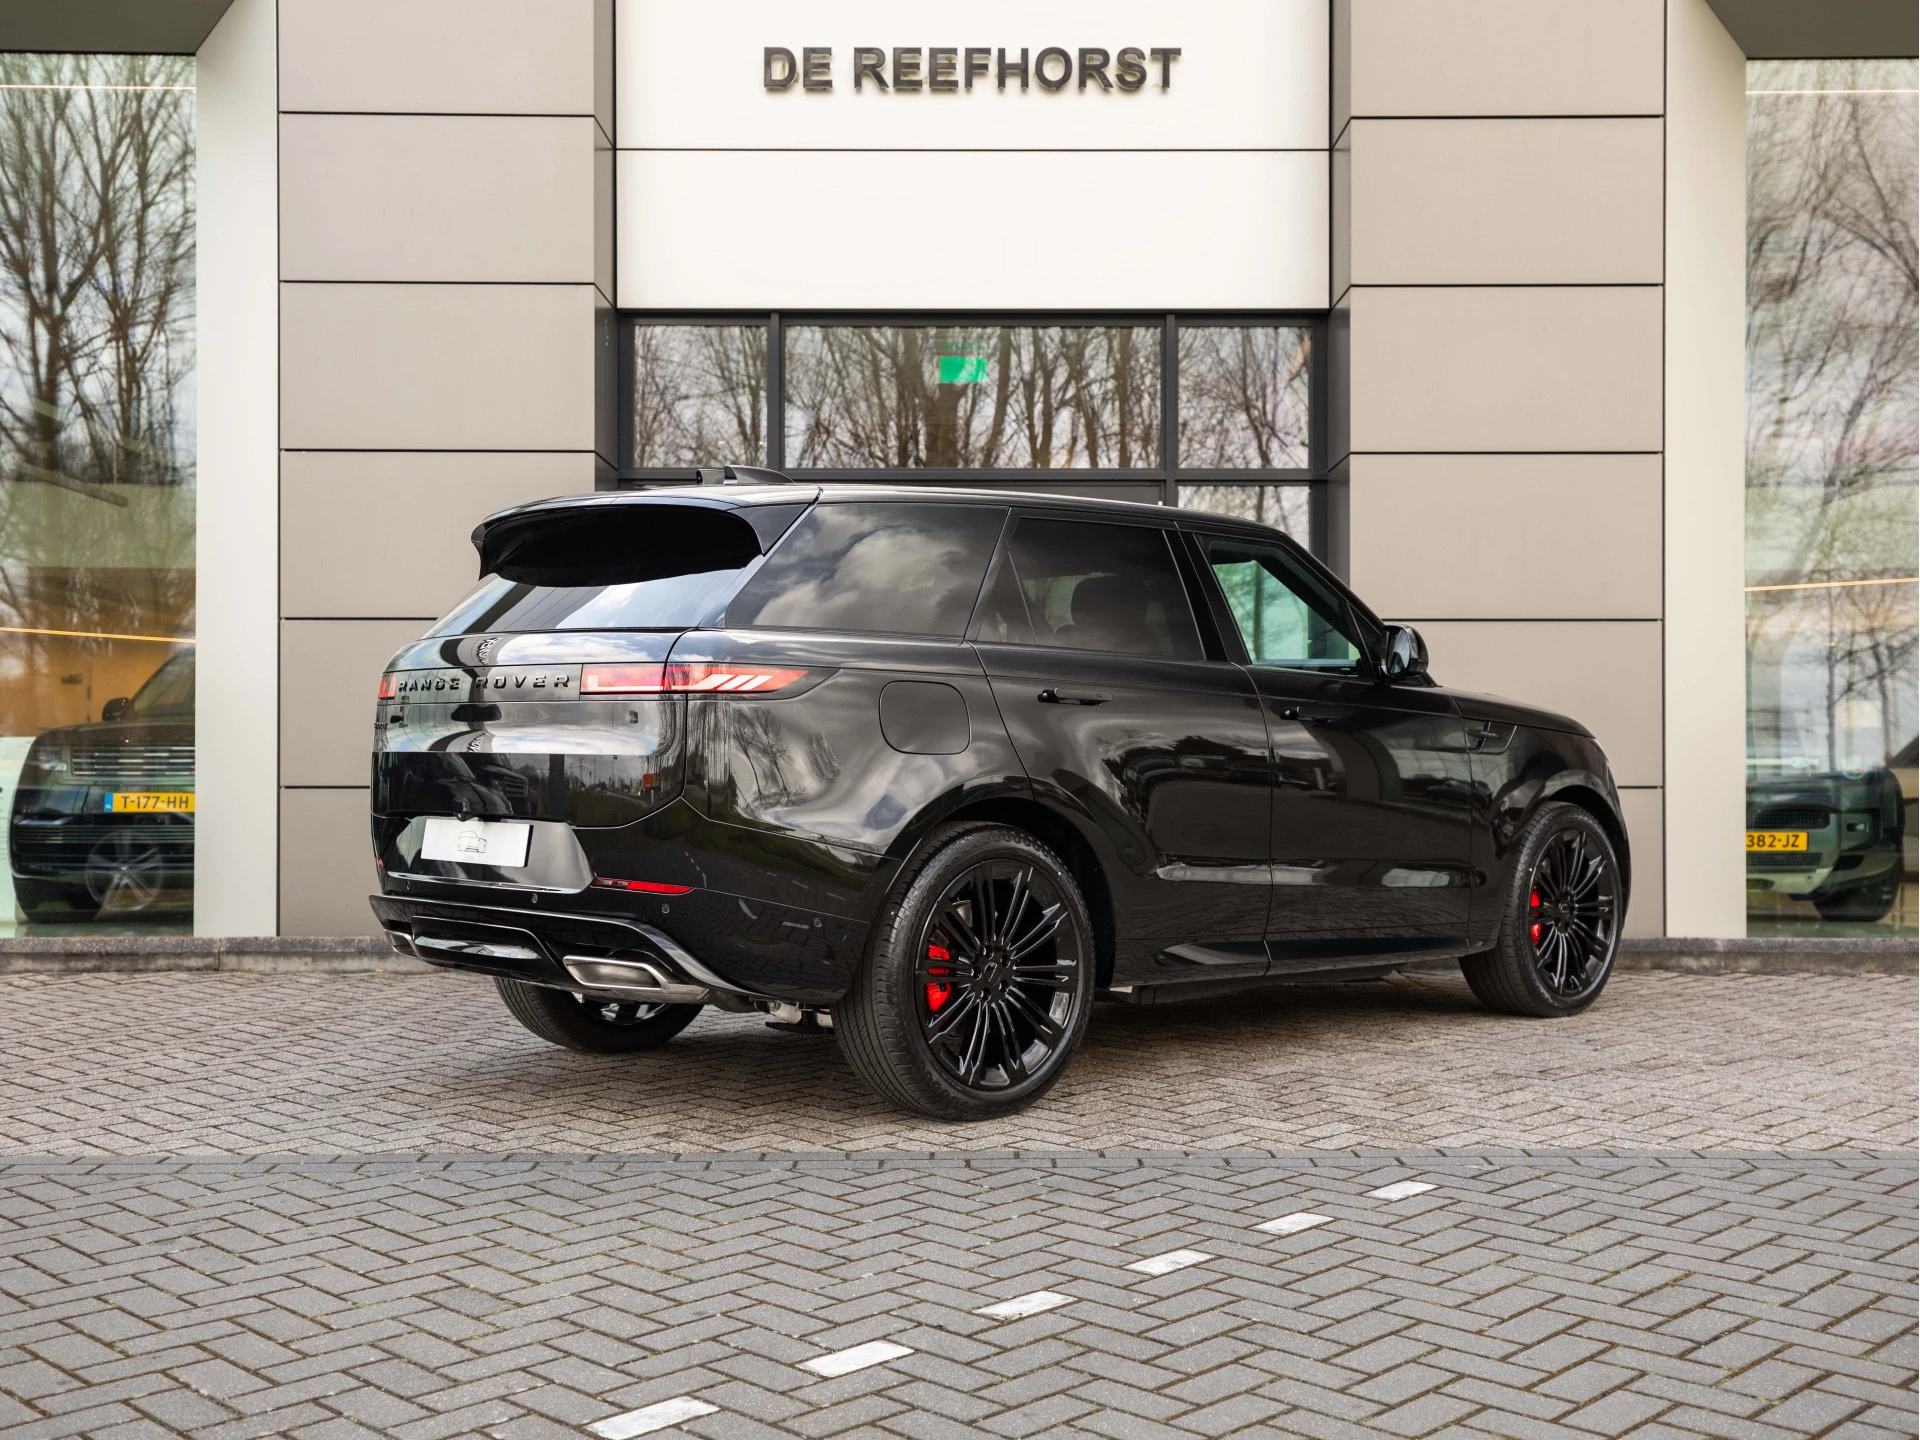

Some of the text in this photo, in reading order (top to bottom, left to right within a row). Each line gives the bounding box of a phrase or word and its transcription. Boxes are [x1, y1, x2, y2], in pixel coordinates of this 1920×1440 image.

[764, 47, 1182, 90] DE REEFHORST
[398, 674, 570, 693] RANGE ROVER
[121, 795, 189, 809] T-177-HH
